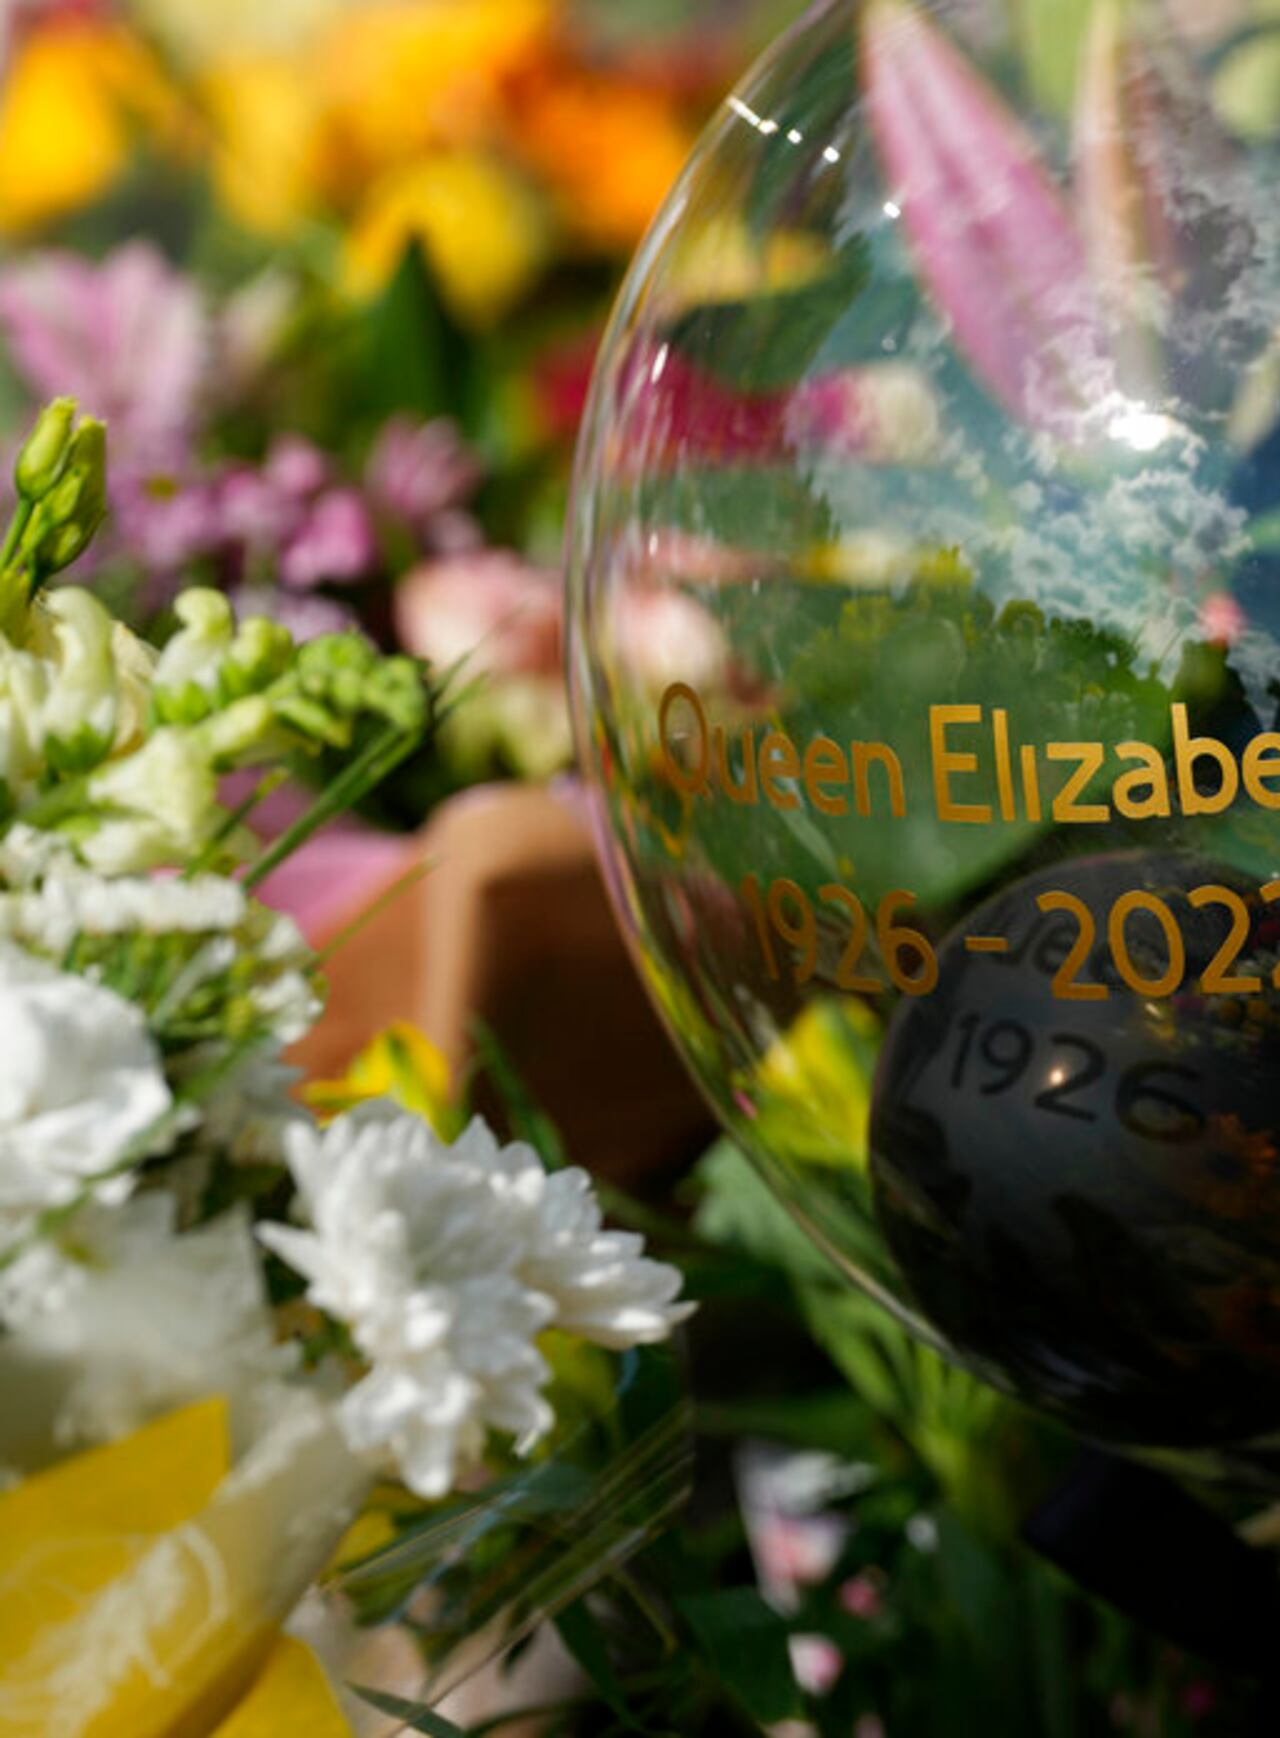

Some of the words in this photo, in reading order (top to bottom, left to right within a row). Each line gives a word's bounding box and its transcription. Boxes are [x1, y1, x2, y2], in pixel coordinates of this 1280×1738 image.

[658, 681, 907, 818] Queen
[740, 872, 940, 996] 1926
[950, 1011, 1200, 1143] 1926
